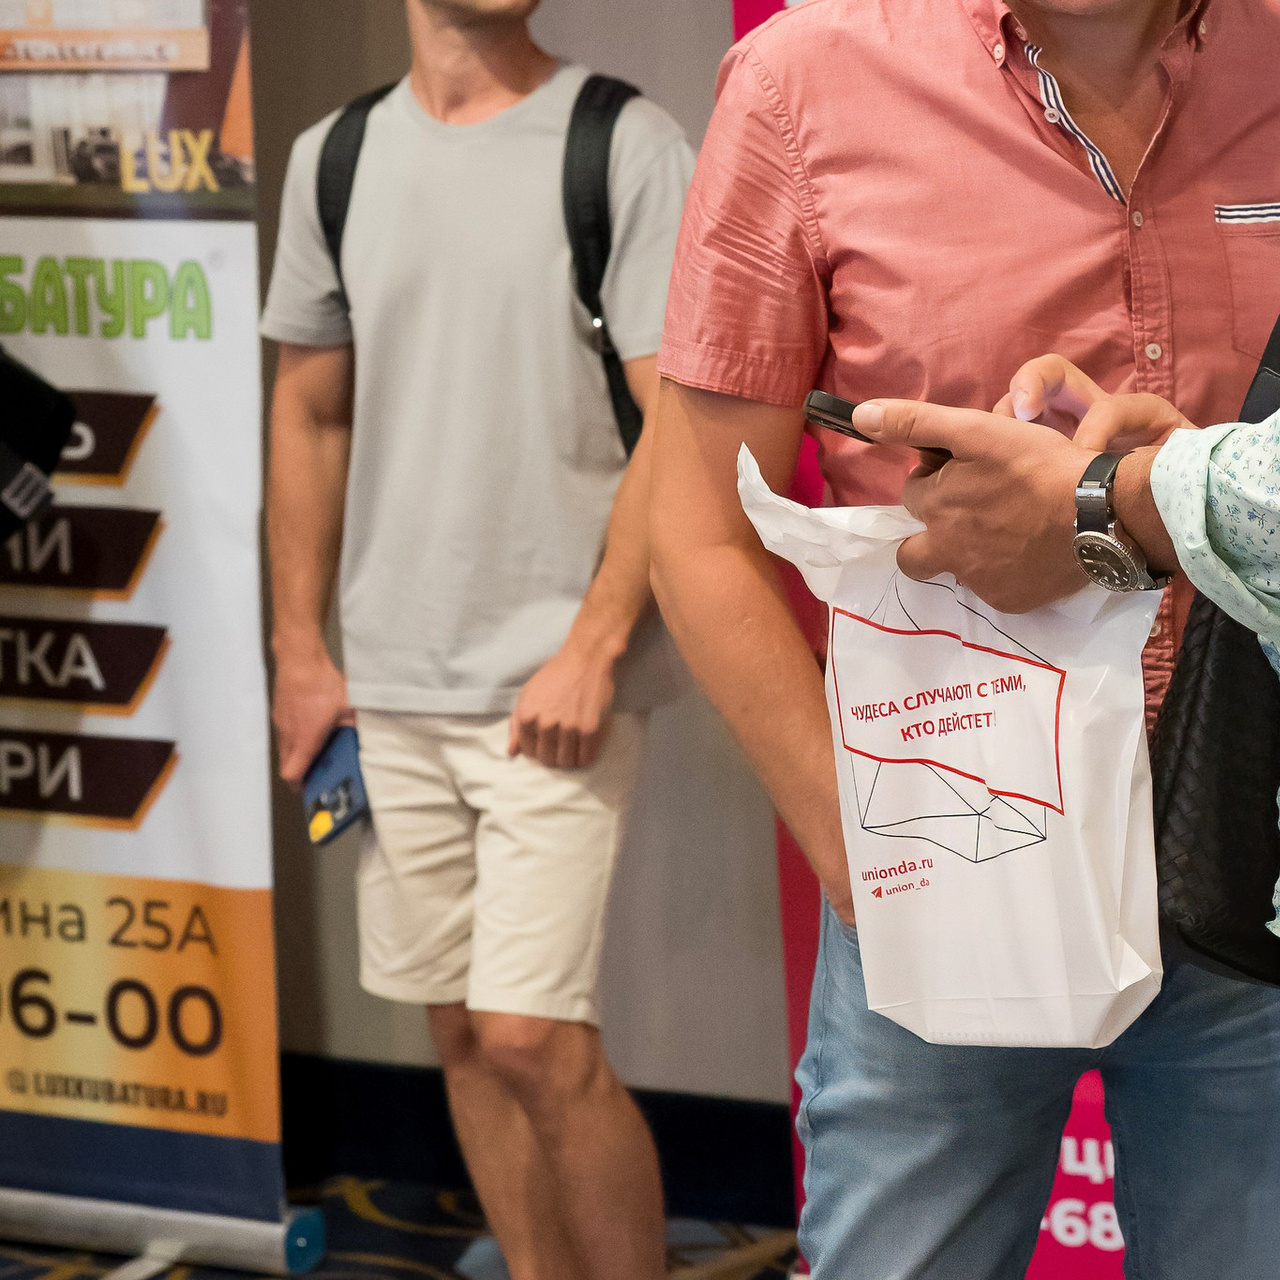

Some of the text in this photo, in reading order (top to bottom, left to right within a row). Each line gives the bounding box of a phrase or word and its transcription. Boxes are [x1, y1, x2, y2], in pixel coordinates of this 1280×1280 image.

[120, 130, 219, 192] LUX
[851, 701, 900, 722] ЧУДЕСА
[976, 682, 988, 698] С
[900, 720, 935, 742] КТО
[861, 858, 934, 881] unionda.ru
[885, 878, 930, 895] union_da
